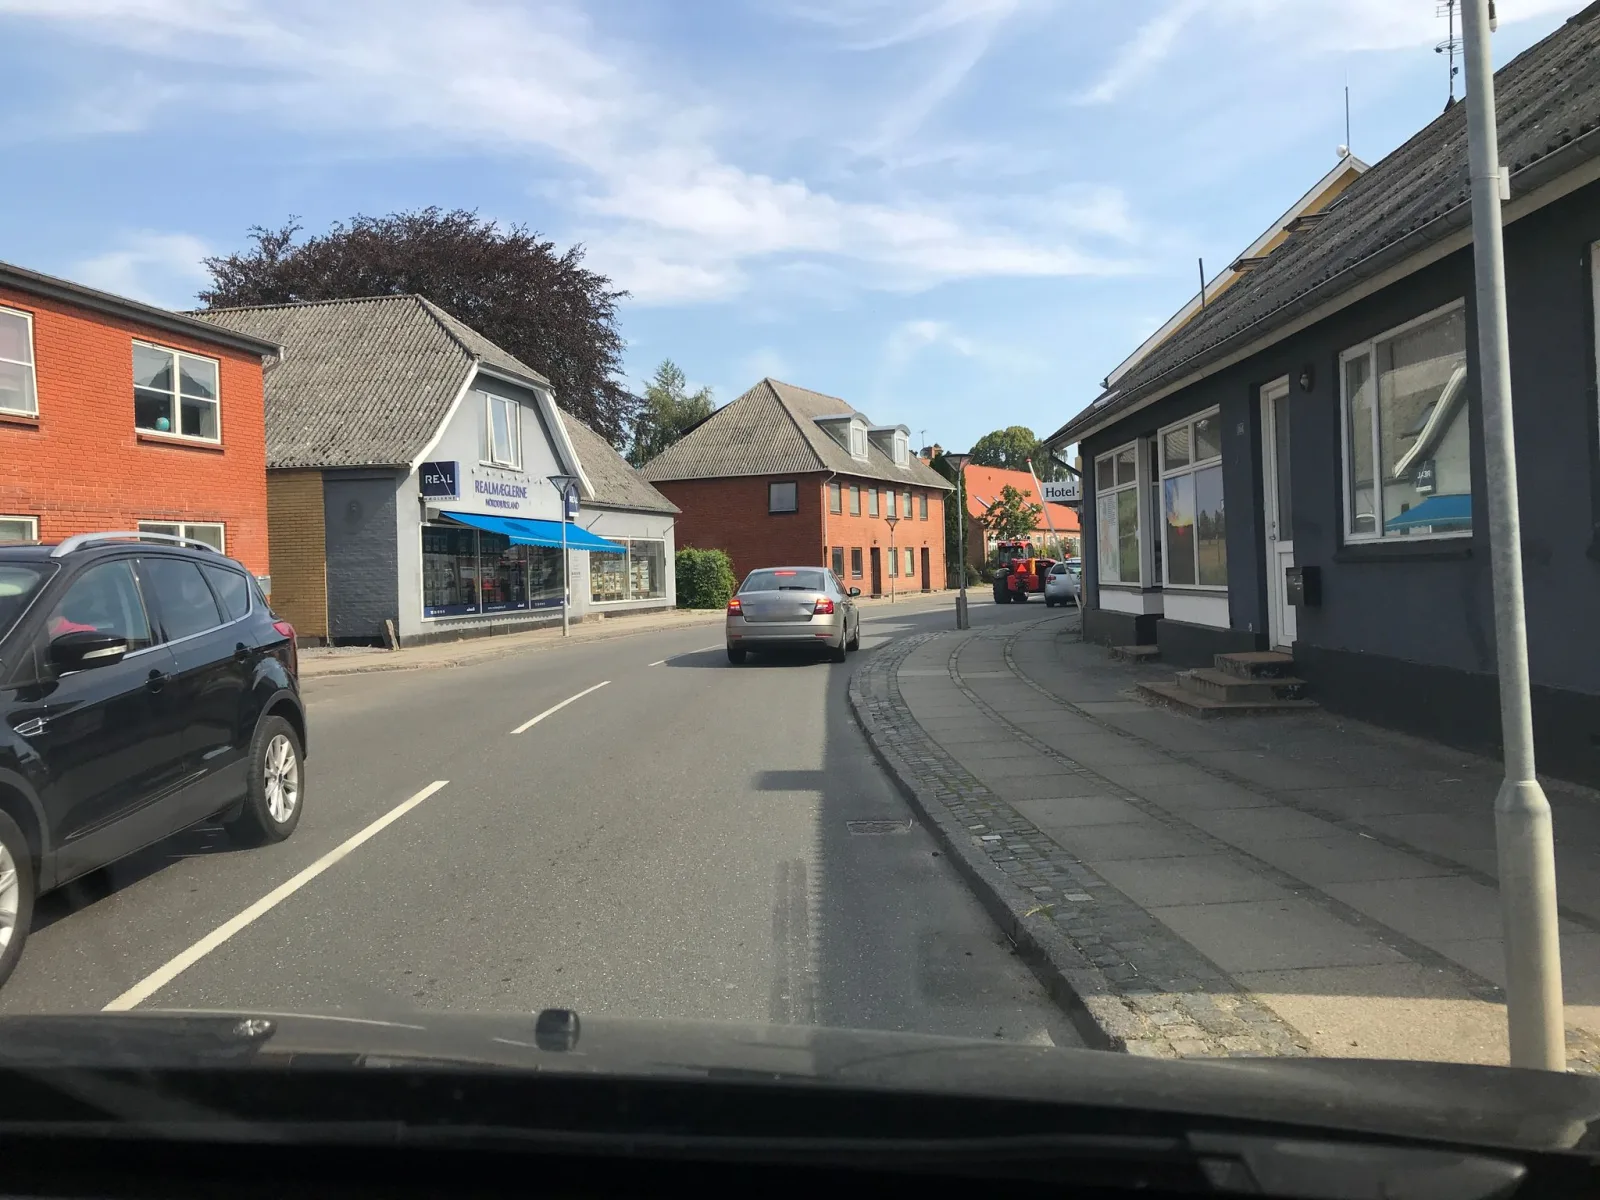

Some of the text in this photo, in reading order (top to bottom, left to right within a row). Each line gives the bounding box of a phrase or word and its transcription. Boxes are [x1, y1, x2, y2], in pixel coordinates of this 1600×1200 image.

[425, 474, 453, 484] REAL
[475, 480, 527, 499] REALMÆGLERNE
[1045, 486, 1076, 498] Hotel
